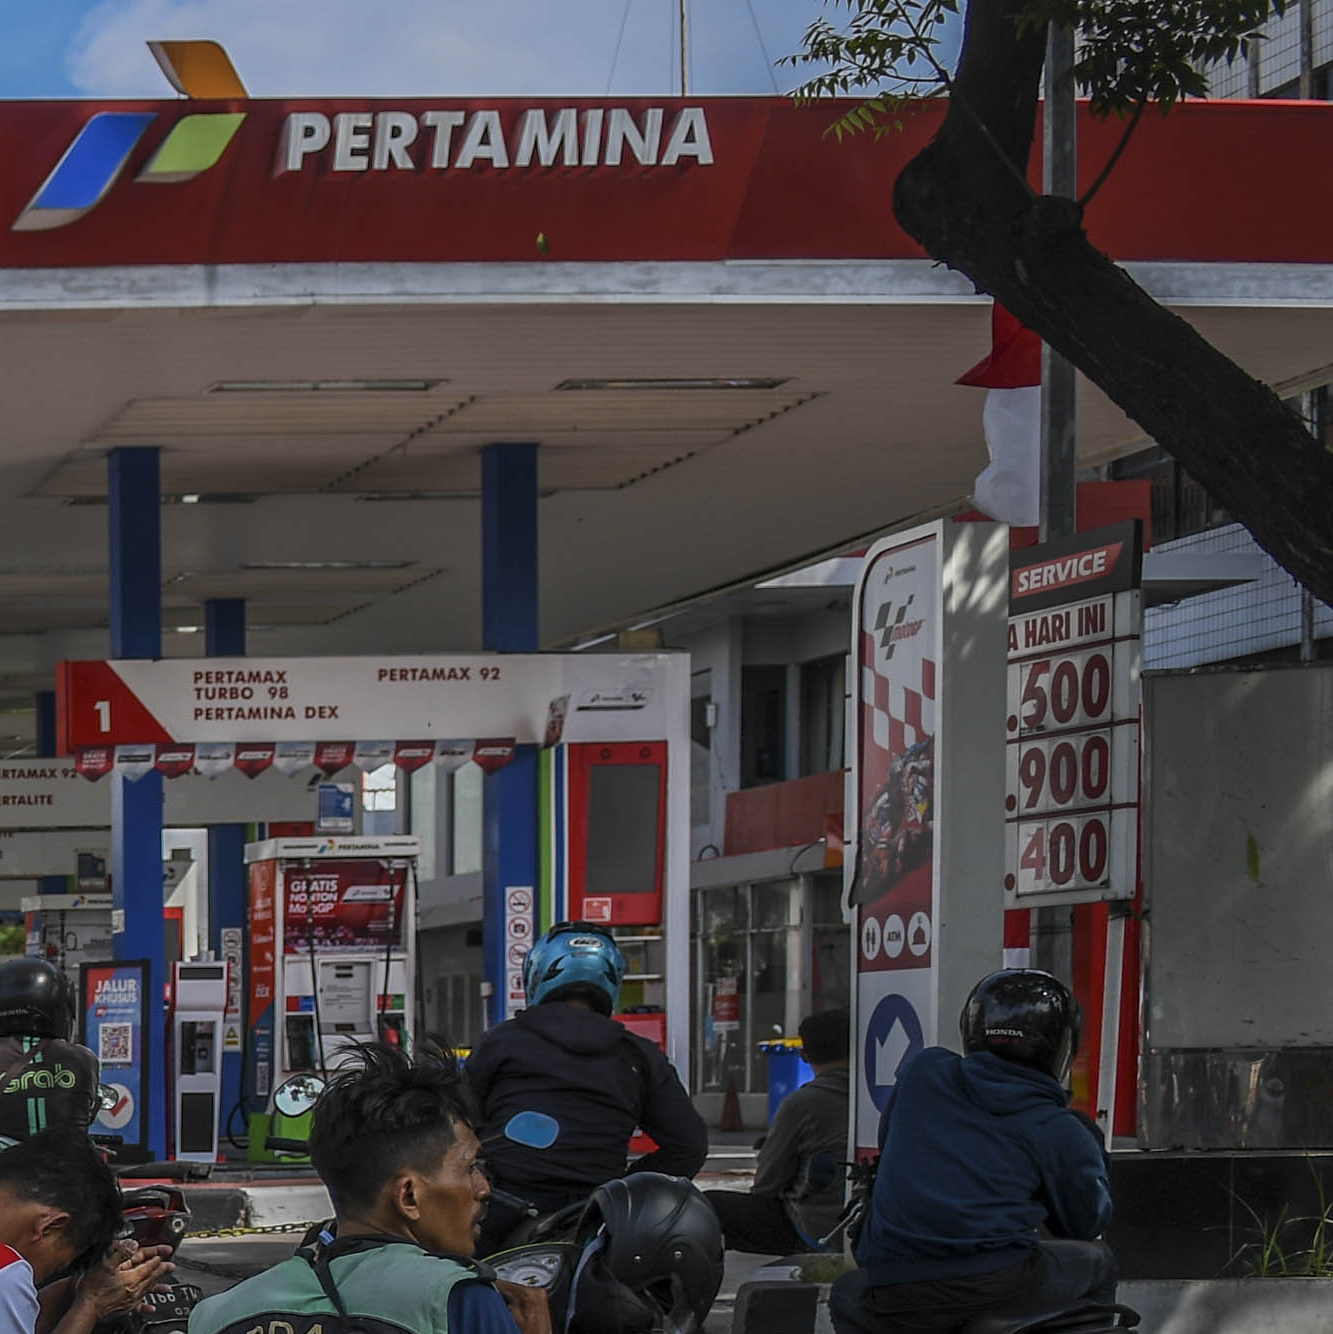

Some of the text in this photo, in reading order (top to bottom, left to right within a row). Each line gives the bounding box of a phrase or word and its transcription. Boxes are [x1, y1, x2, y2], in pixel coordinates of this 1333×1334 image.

[283, 107, 715, 172] PERTAMINA
[1018, 550, 1107, 593] SERVICE
[1024, 610, 1071, 649] HARI
[1078, 602, 1106, 637] INI
[193, 670, 287, 685] PERTAMAX
[378, 667, 501, 682] PERTAMAX 92
[194, 686, 289, 701] TURBO 98
[93, 700, 112, 733] 1
[193, 705, 339, 721] PERTAMINA DEX
[63, 767, 78, 779] 92
[886, 930, 902, 943] ATM
[95, 979, 137, 993] JALUR
[986, 1028, 1024, 1038] HONDA
